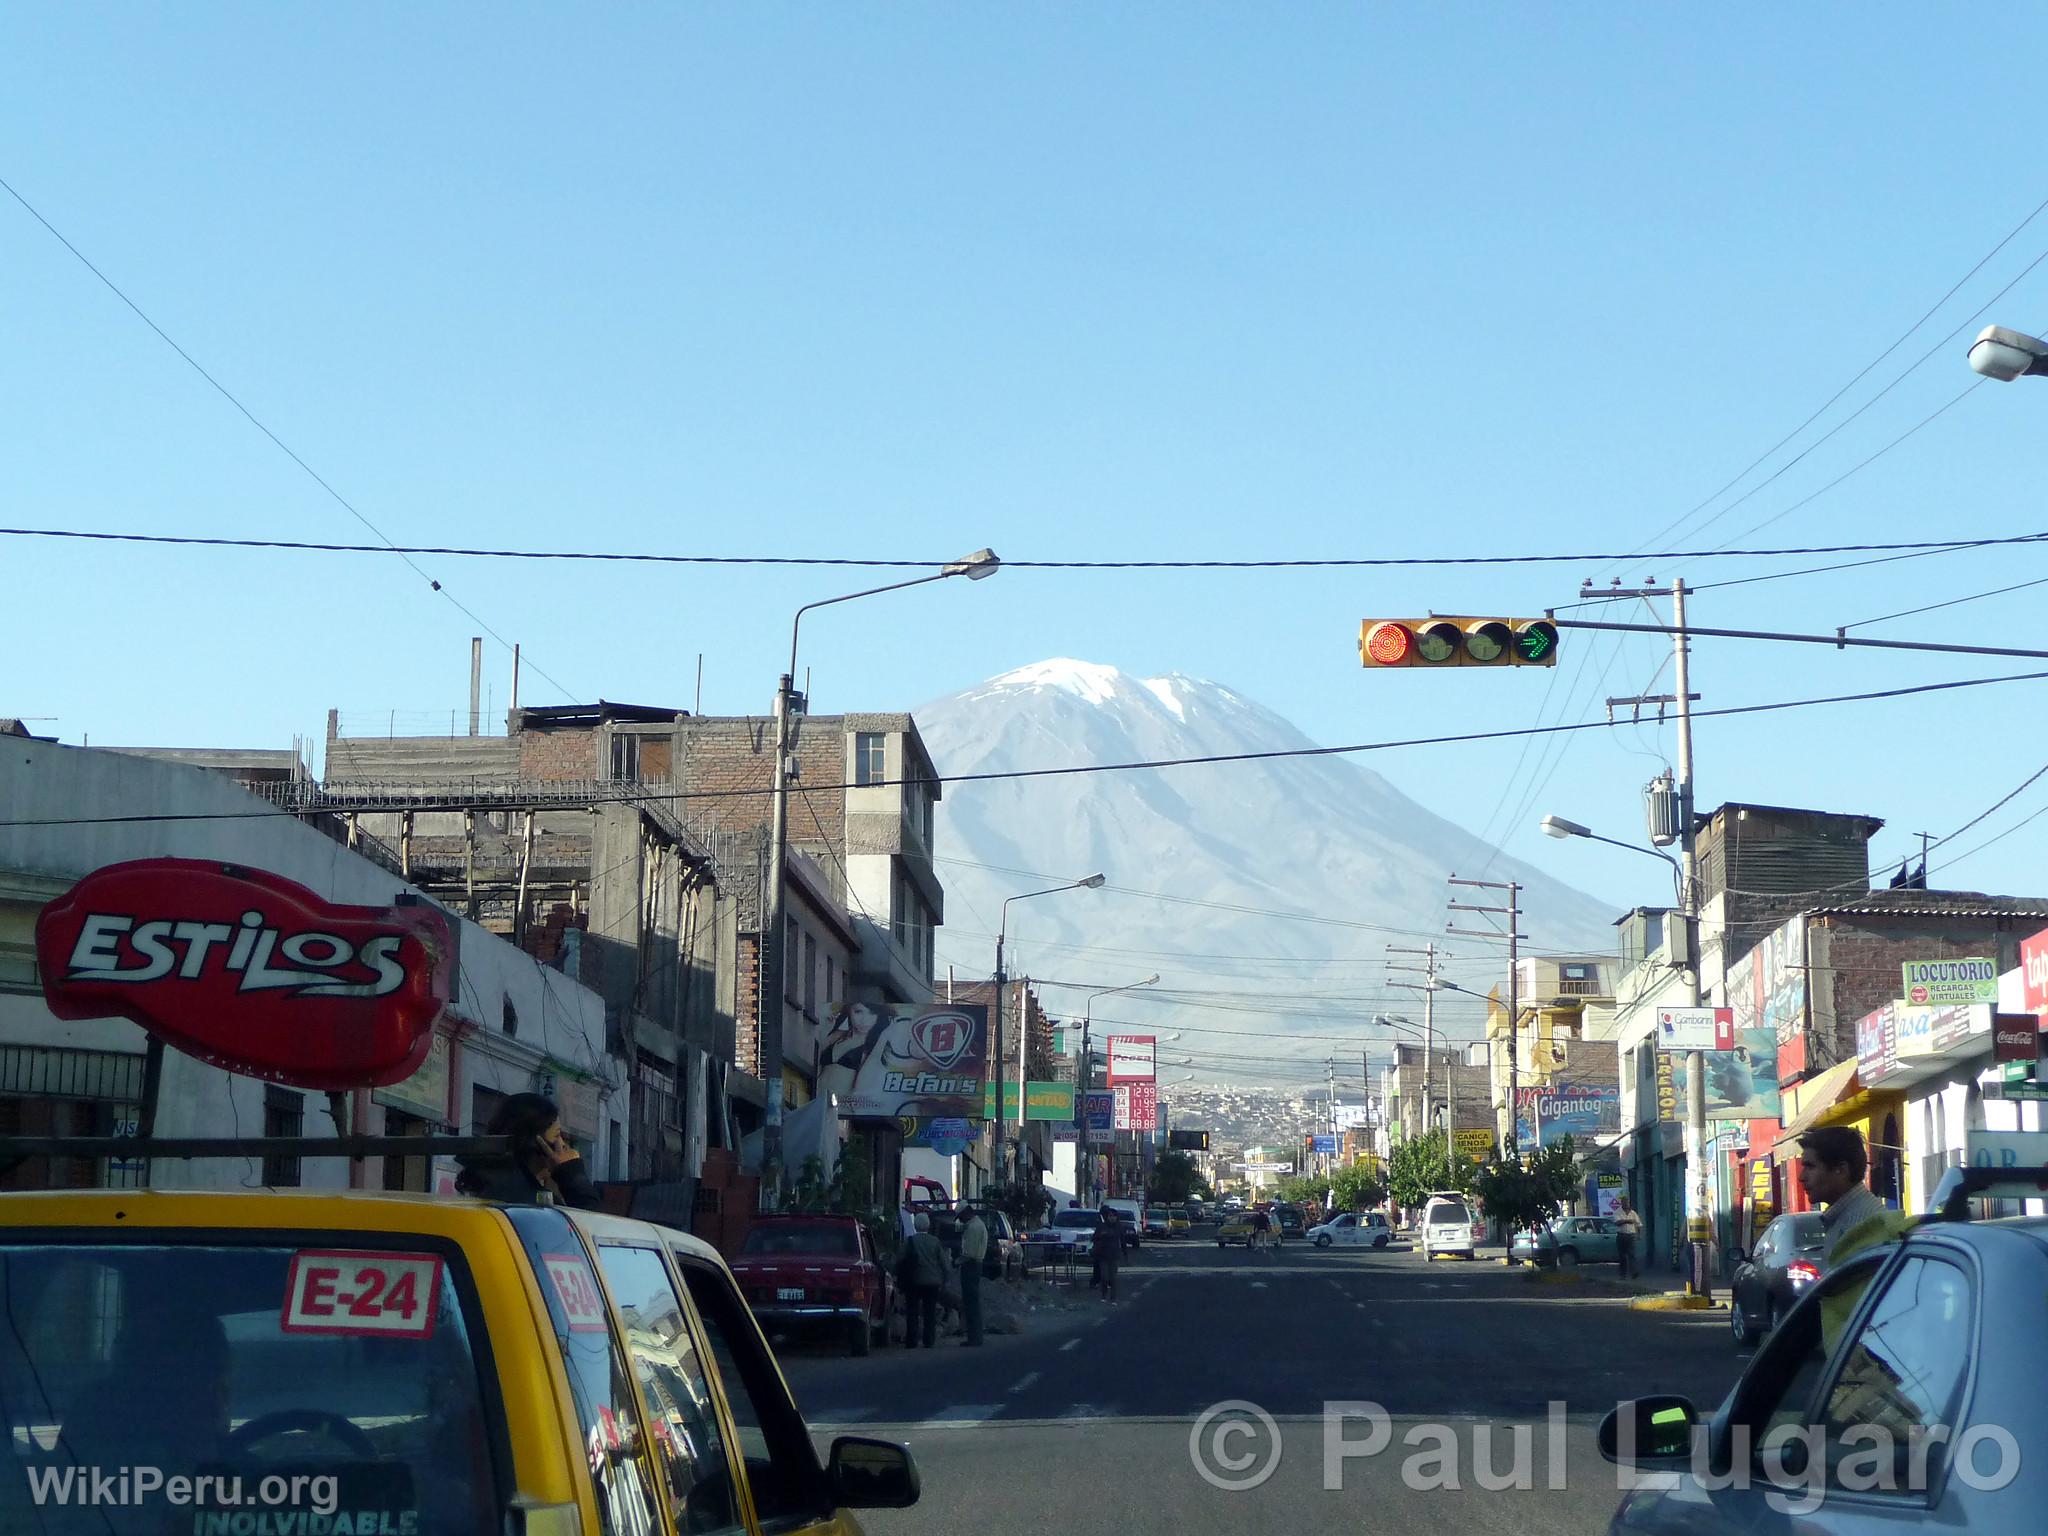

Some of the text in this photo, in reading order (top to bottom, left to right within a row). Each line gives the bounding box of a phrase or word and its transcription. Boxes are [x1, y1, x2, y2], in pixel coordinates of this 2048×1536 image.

[1910, 961, 1994, 983] LOCUTORIO
[1930, 984, 1974, 992] RECARGAS
[1930, 992, 1975, 1001] VIRTUALES
[1116, 1098, 1127, 1107] 84
[301, 1267, 418, 1320] E-24
[193, 1510, 418, 1536] INOLVIDABLE
